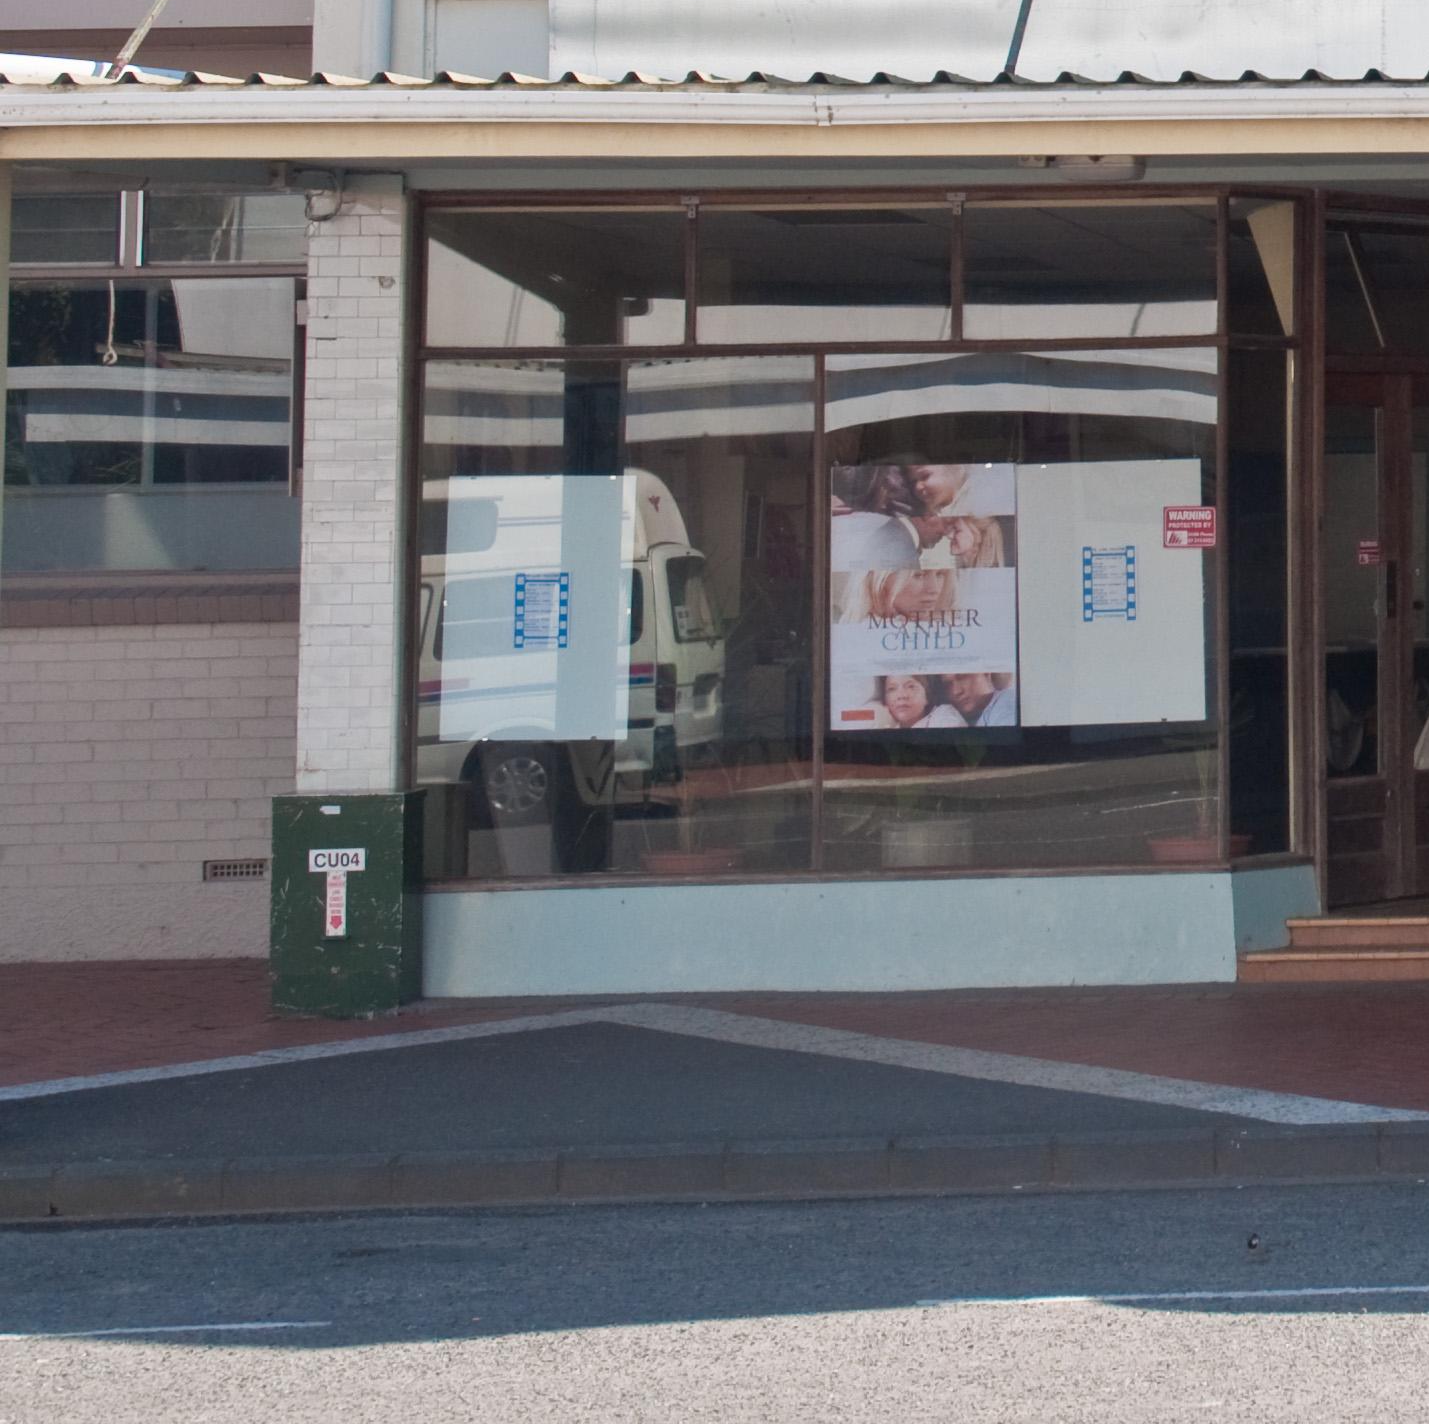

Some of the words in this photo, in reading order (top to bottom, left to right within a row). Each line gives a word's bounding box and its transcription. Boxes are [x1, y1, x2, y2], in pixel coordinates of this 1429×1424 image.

[1168, 510, 1212, 521] WARNING
[868, 609, 983, 629] MOTHER
[881, 629, 967, 652] CHILD
[314, 853, 360, 868] CU04
